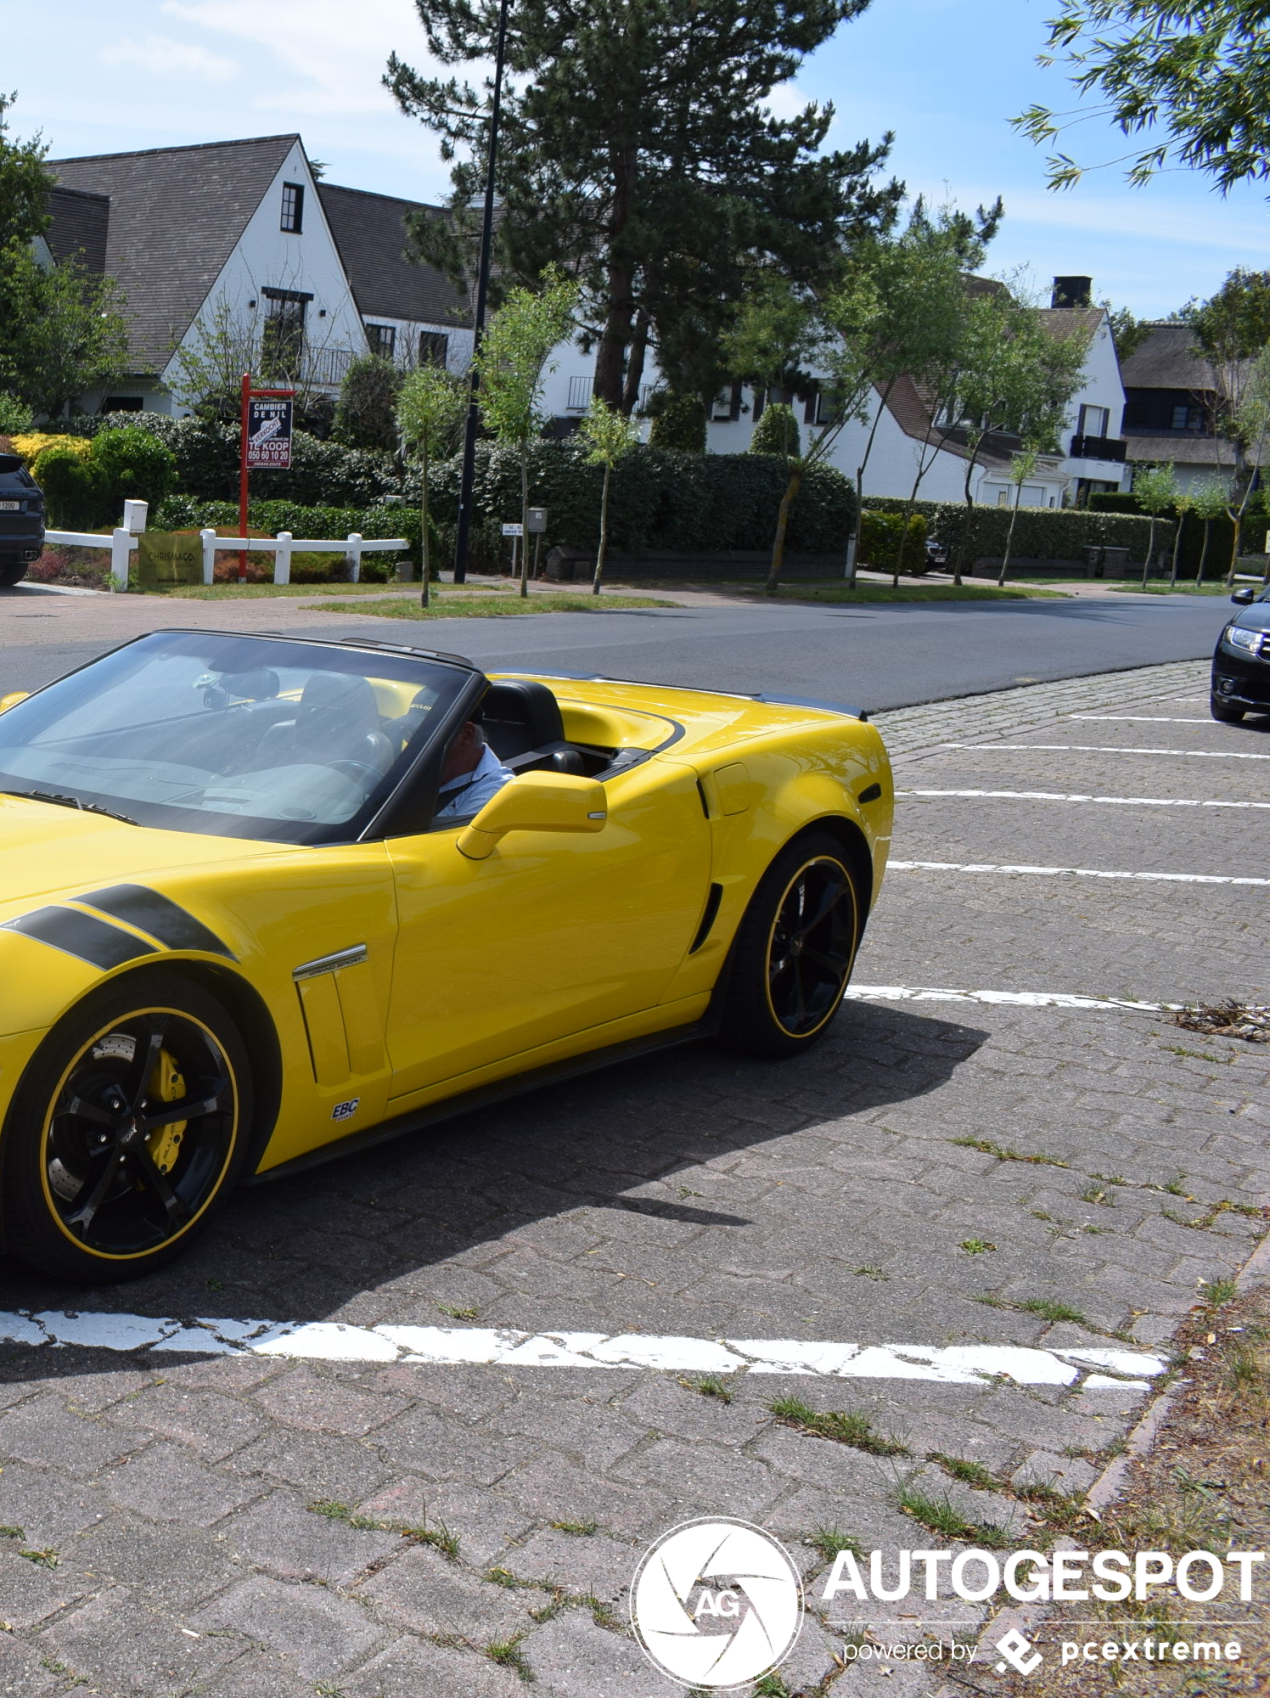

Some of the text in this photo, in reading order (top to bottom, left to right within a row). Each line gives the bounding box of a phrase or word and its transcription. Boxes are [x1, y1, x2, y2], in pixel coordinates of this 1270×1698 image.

[254, 403, 286, 411] CAMBIER
[253, 419, 279, 442] VERKOCHT
[263, 442, 288, 450] KOOP
[248, 451, 288, 459] 050 60 10 20
[332, 1099, 358, 1118] EBC
